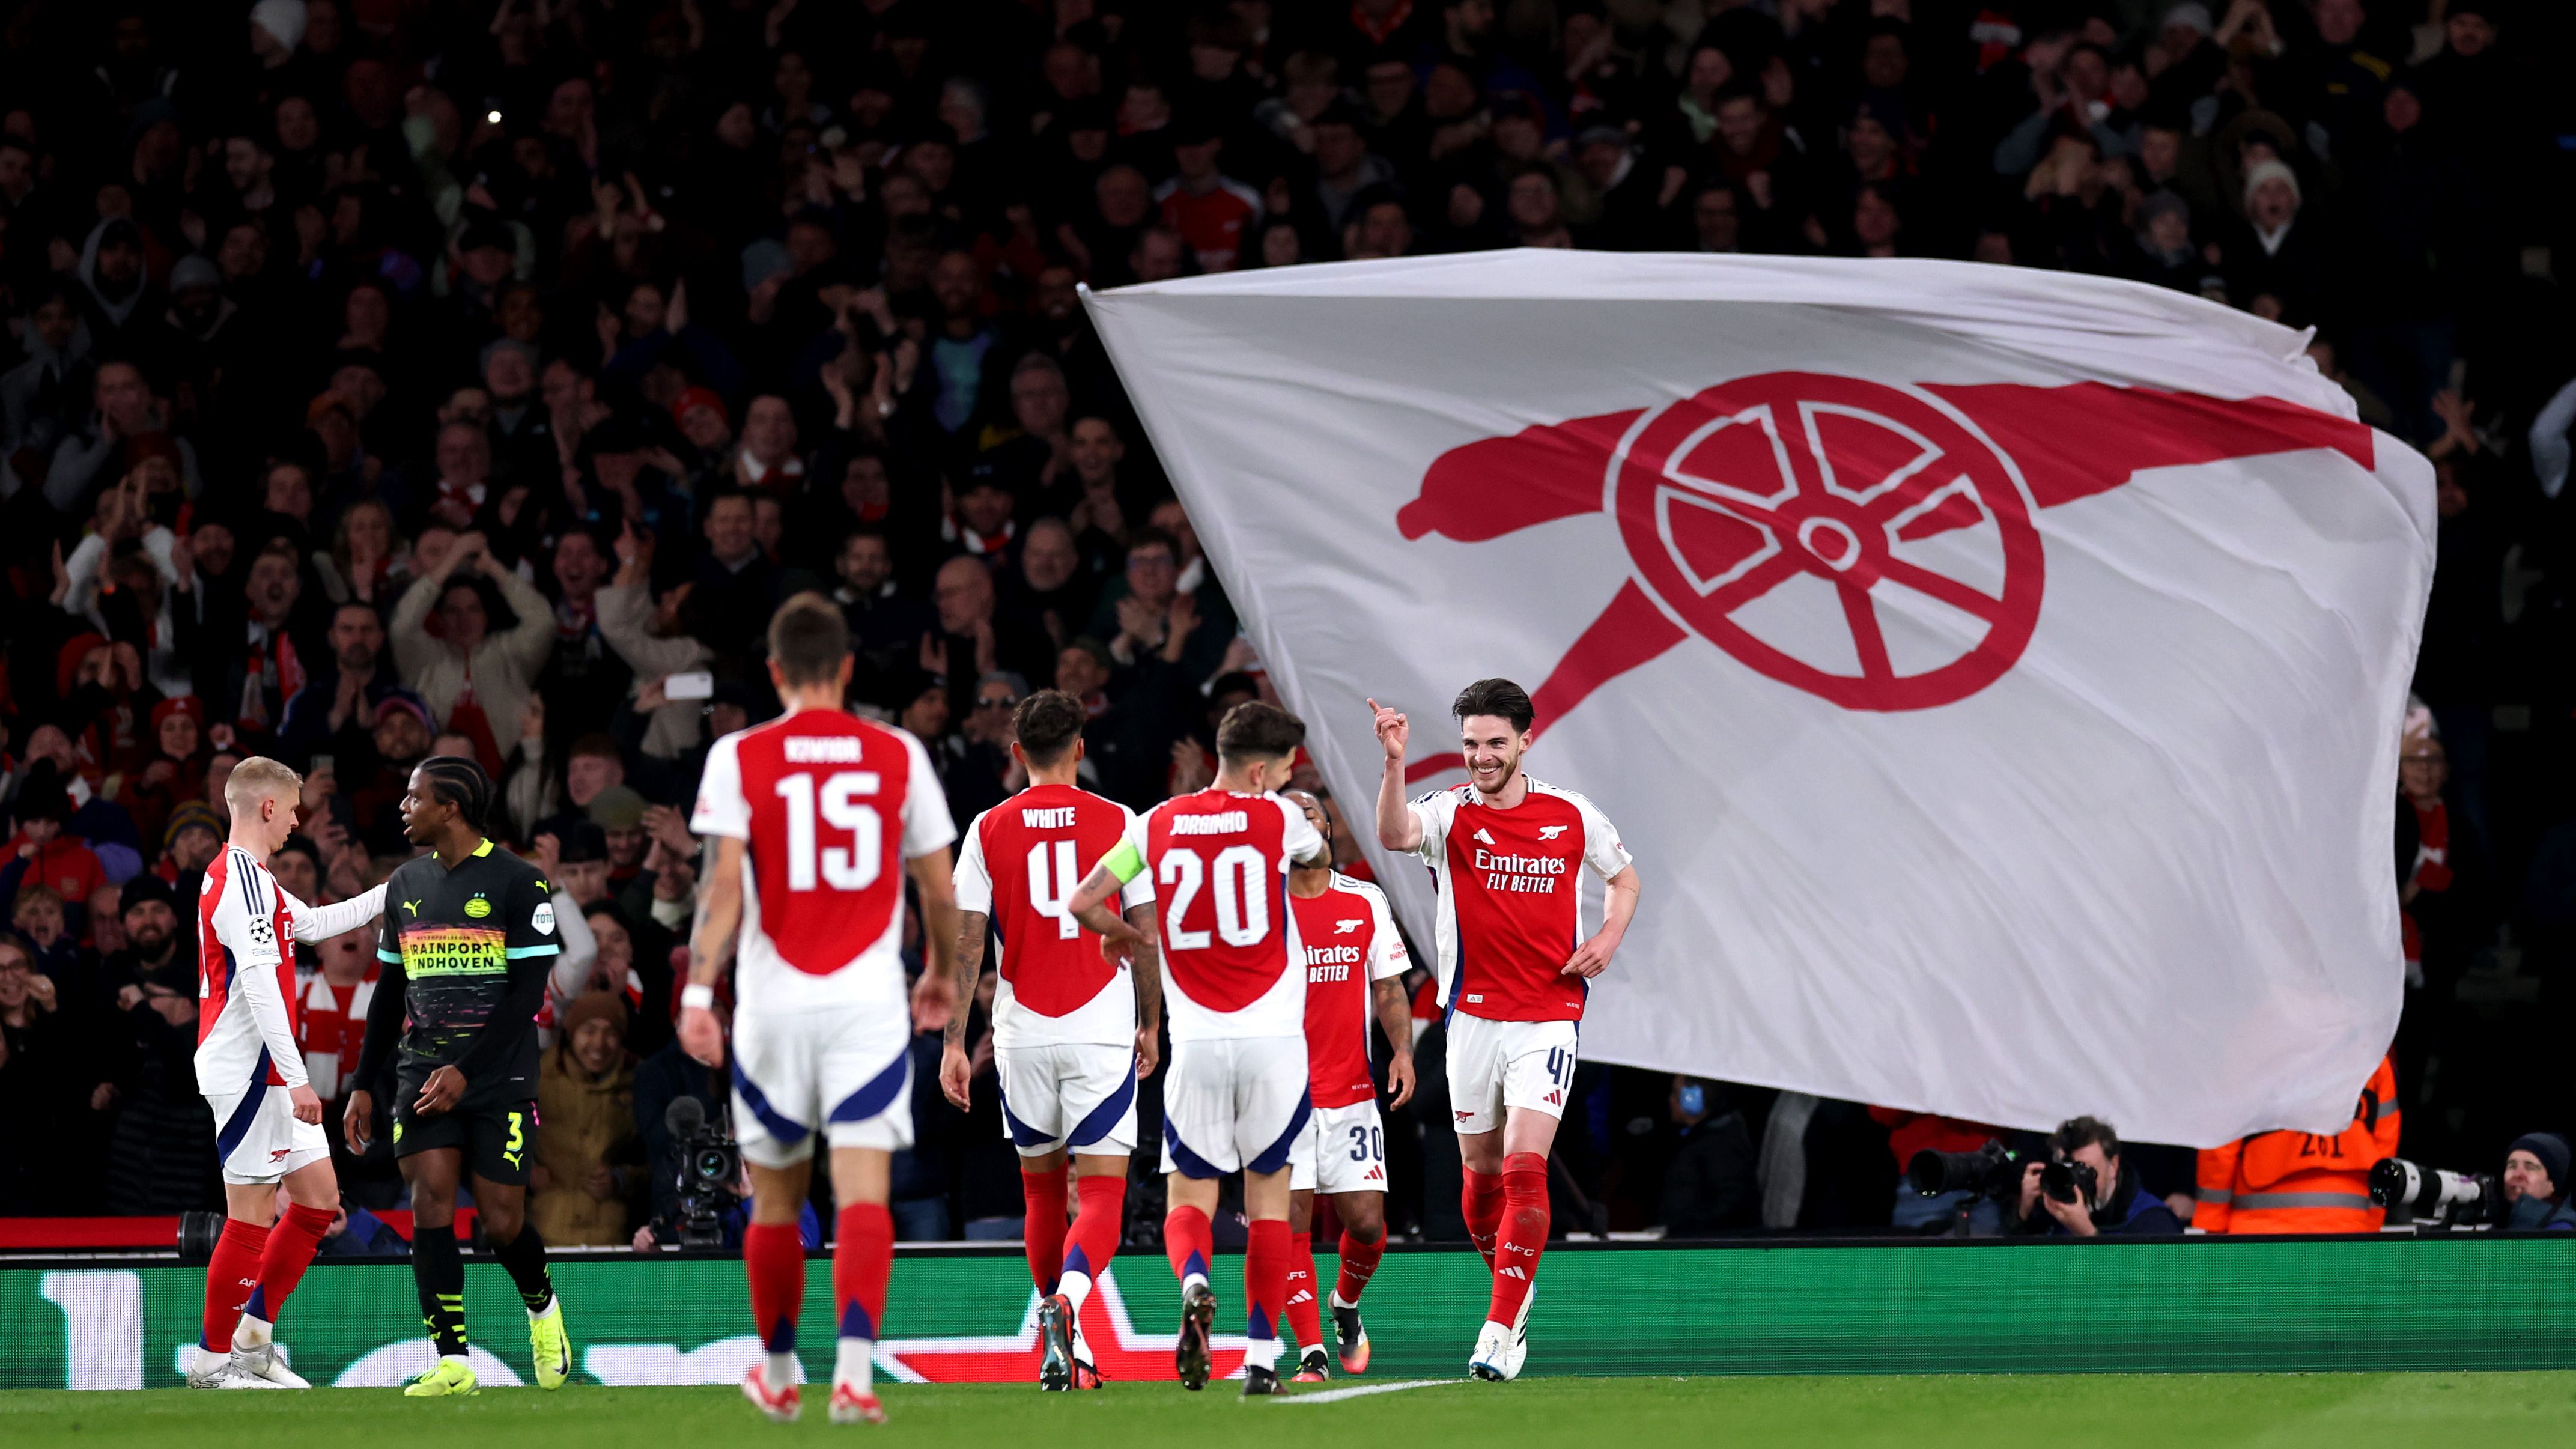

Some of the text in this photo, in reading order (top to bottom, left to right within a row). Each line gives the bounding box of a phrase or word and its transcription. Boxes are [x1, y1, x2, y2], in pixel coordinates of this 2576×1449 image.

[1022, 807, 1076, 828] WHITE
[1169, 810, 1248, 836] JORGINHO
[776, 771, 881, 892] 15
[1475, 848, 1566, 875] Emirates
[1027, 840, 1080, 940] 4
[1486, 873, 1555, 893] FLY BETTER
[1159, 844, 1270, 950] 20
[1305, 944, 1360, 965] irates
[1309, 965, 1349, 983] BETTER
[1546, 1045, 1573, 1090] 41
[506, 1111, 523, 1152] 3
[1350, 1126, 1383, 1161] 30
[1504, 1242, 1535, 1257] AFC
[238, 1278, 257, 1288] AF
[1287, 1270, 1307, 1281] FC
